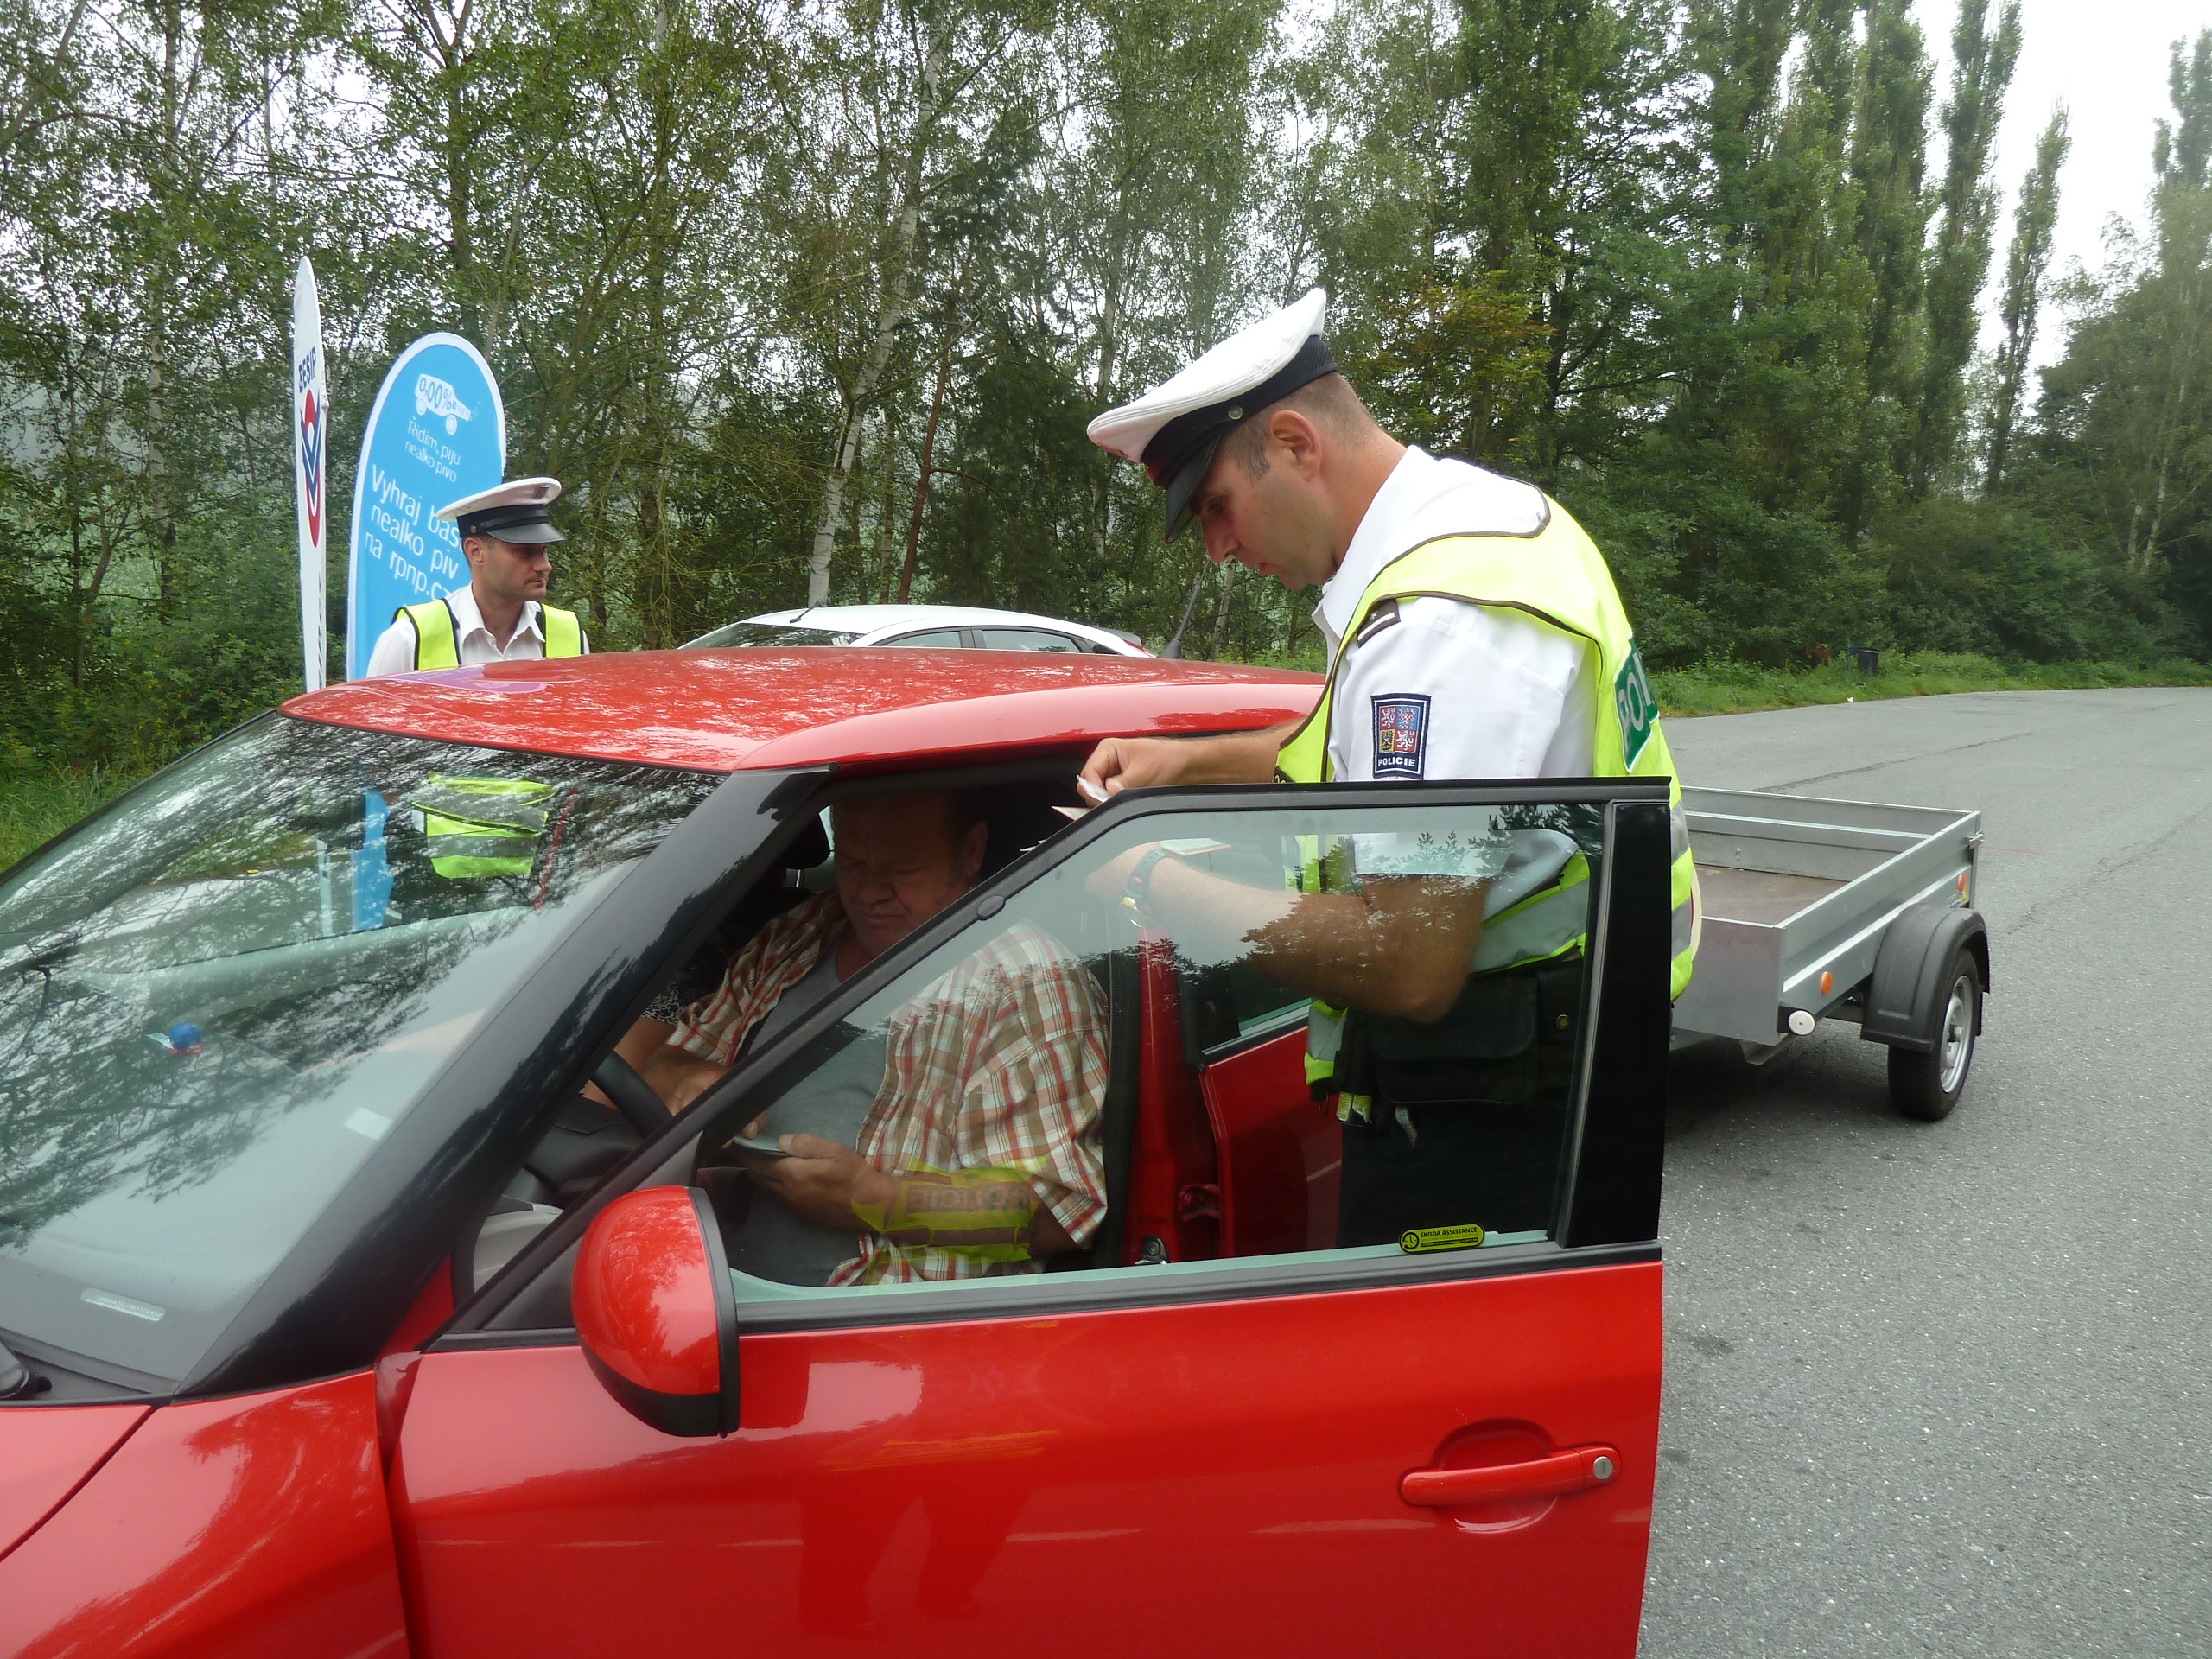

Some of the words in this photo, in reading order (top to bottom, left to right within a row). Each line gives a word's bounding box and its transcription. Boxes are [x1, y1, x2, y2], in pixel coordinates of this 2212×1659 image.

[298, 346, 316, 394] BESIP
[404, 441, 435, 467] nealko
[435, 461, 457, 482] pivo
[441, 445, 461, 465] piju
[372, 464, 421, 526] Vyhraj
[428, 505, 462, 552] bas
[365, 531, 383, 560] na
[371, 505, 424, 556] nealko
[430, 549, 459, 580] piv
[1377, 756, 1416, 767] POLICIE
[1442, 1227, 1478, 1236] ASSISTANCE
